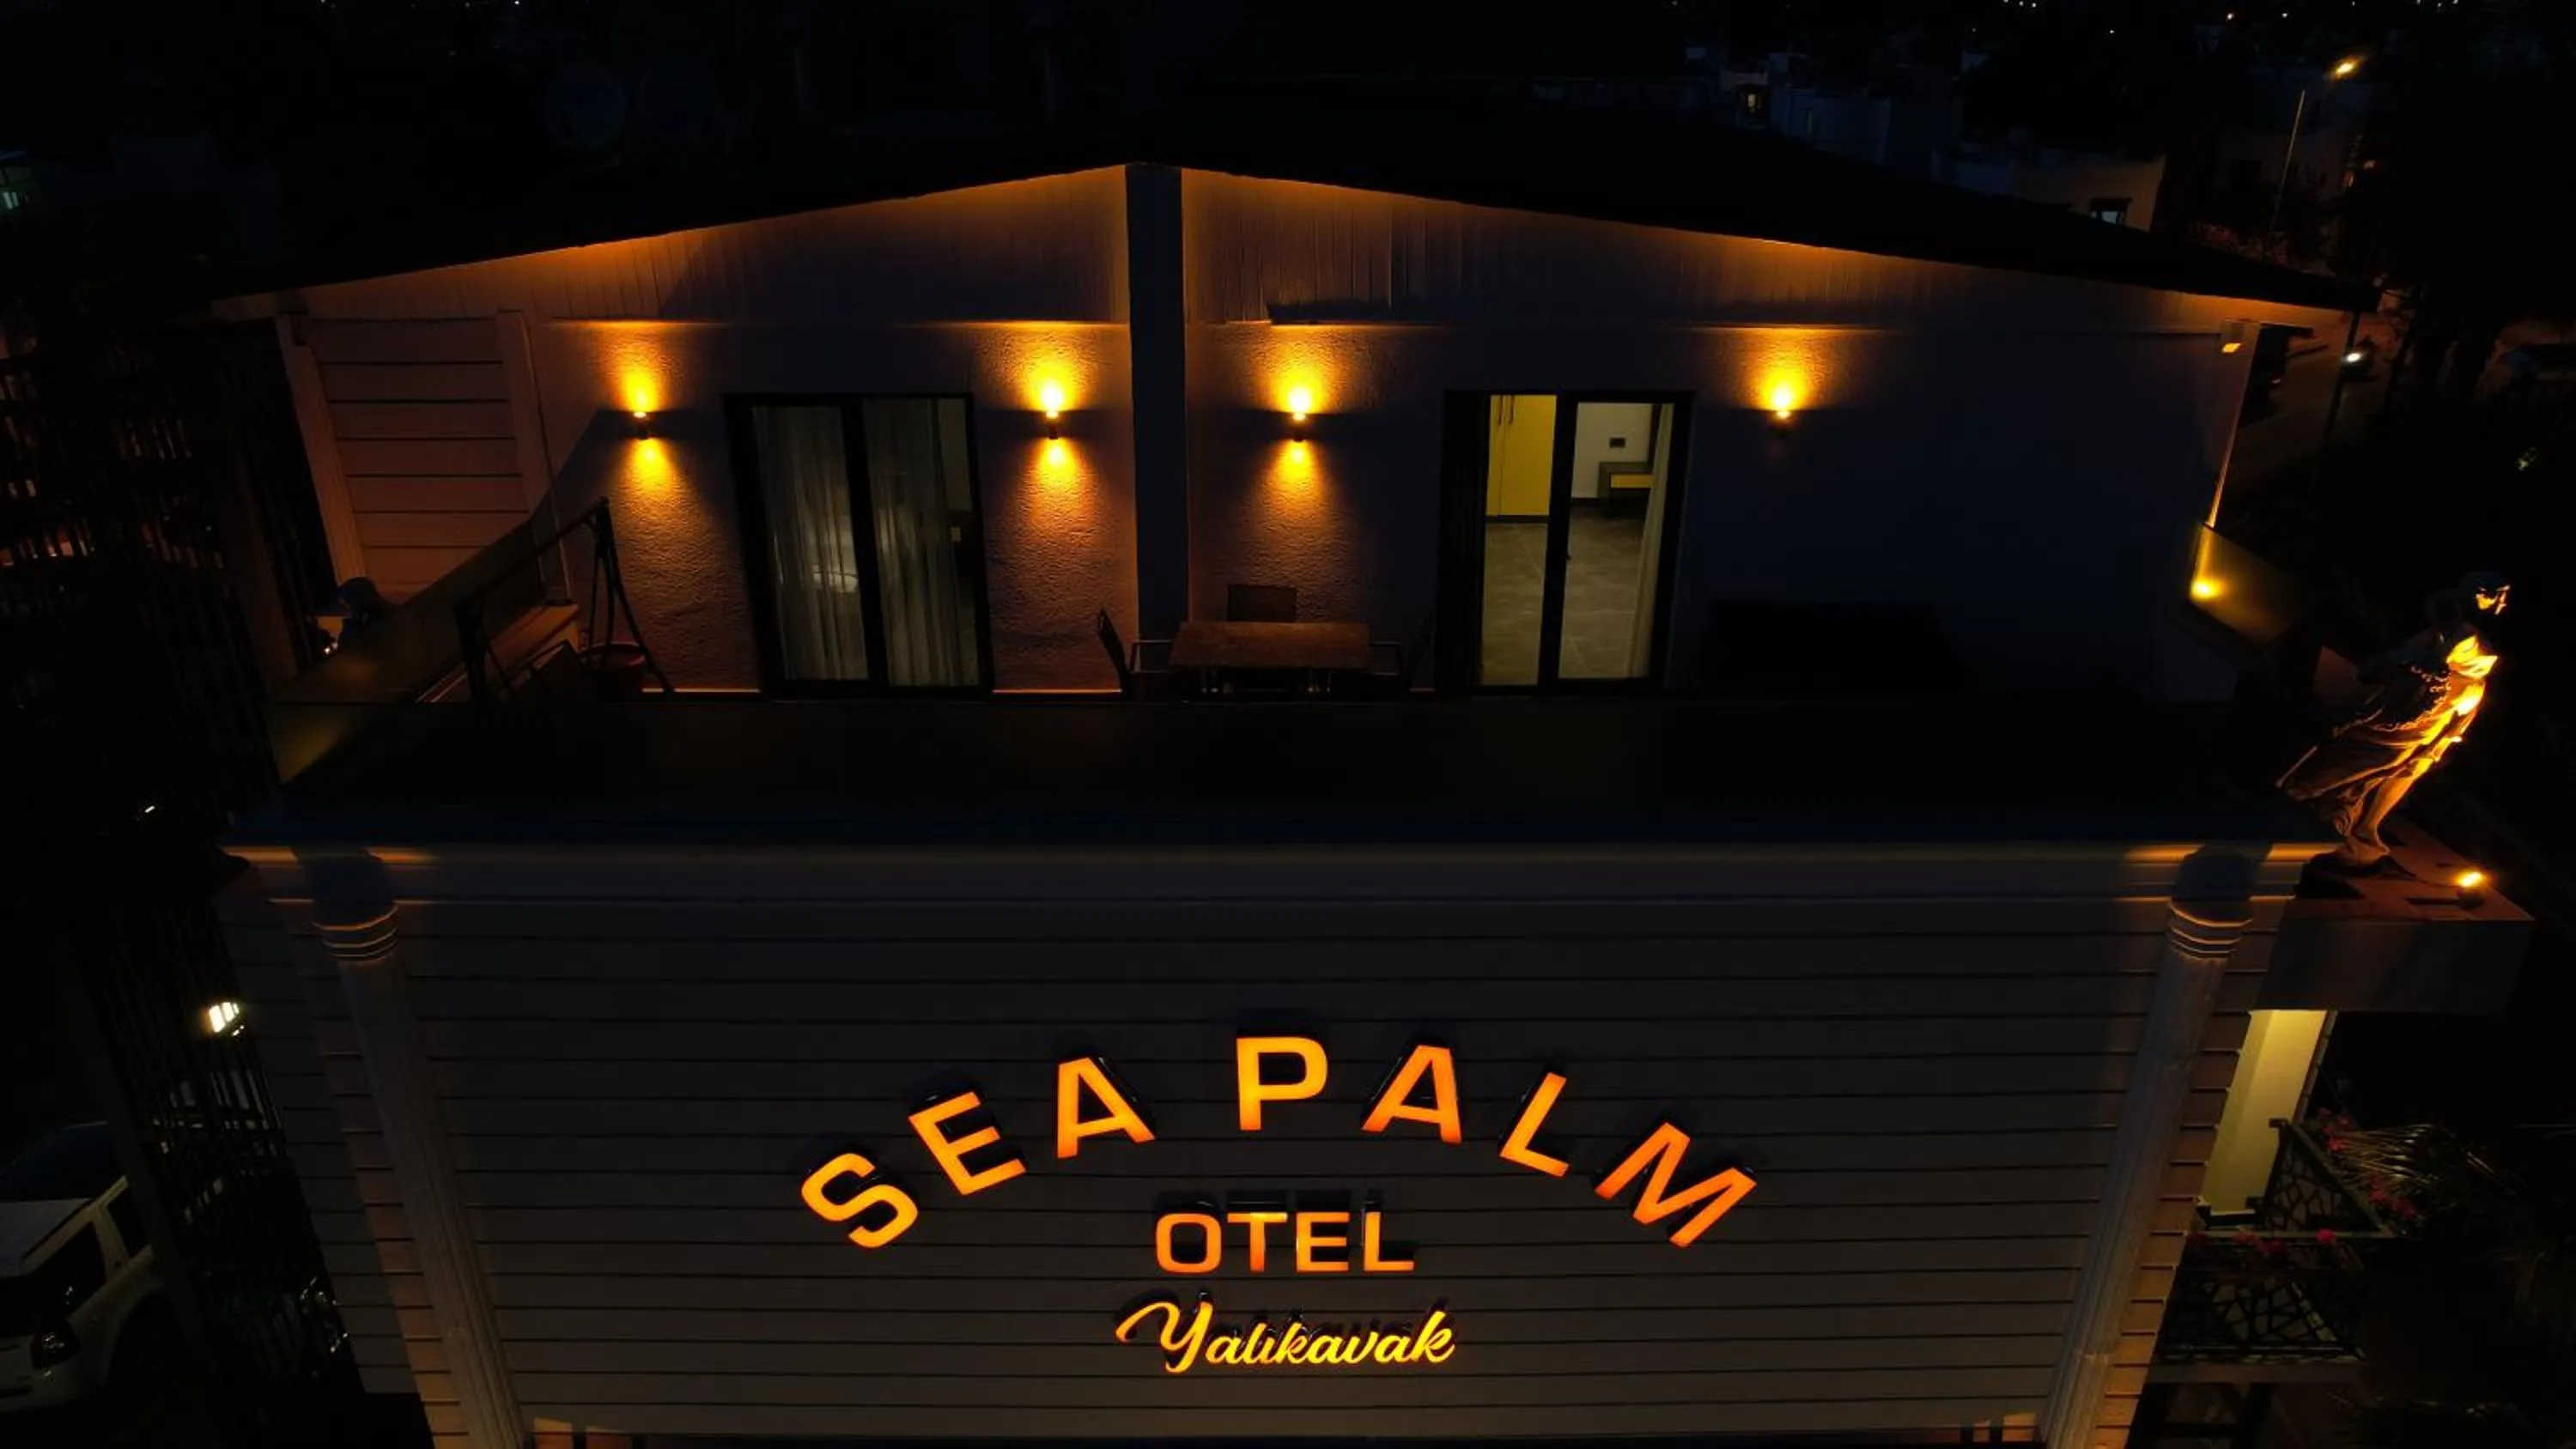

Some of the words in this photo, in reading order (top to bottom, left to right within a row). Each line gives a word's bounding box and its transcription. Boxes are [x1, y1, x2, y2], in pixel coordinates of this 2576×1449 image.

[800, 1056, 1156, 1249] SEA
[1235, 1035, 1757, 1248] PALM
[1155, 1210, 1415, 1275] OTEL
